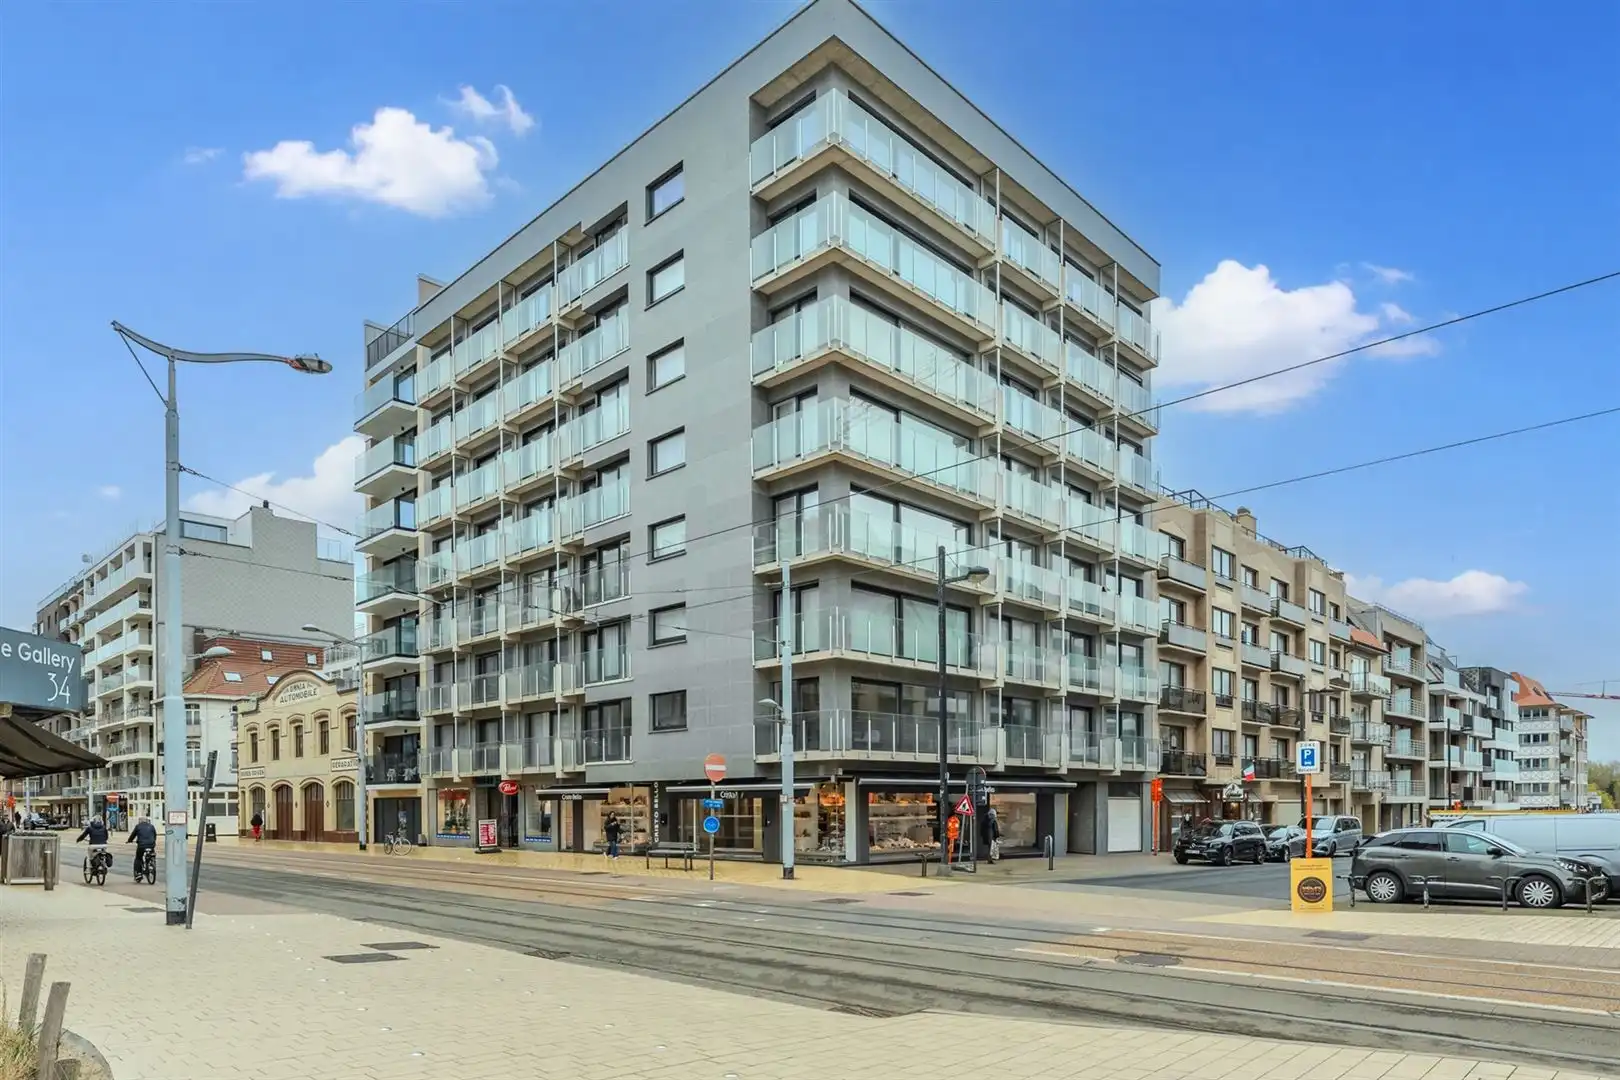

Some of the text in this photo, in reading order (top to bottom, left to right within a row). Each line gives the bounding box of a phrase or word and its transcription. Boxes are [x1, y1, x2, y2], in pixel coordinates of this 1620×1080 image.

[18, 642, 75, 673] Gallery
[47, 672, 71, 705] 34
[280, 687, 318, 703] AUTOMOBILE
